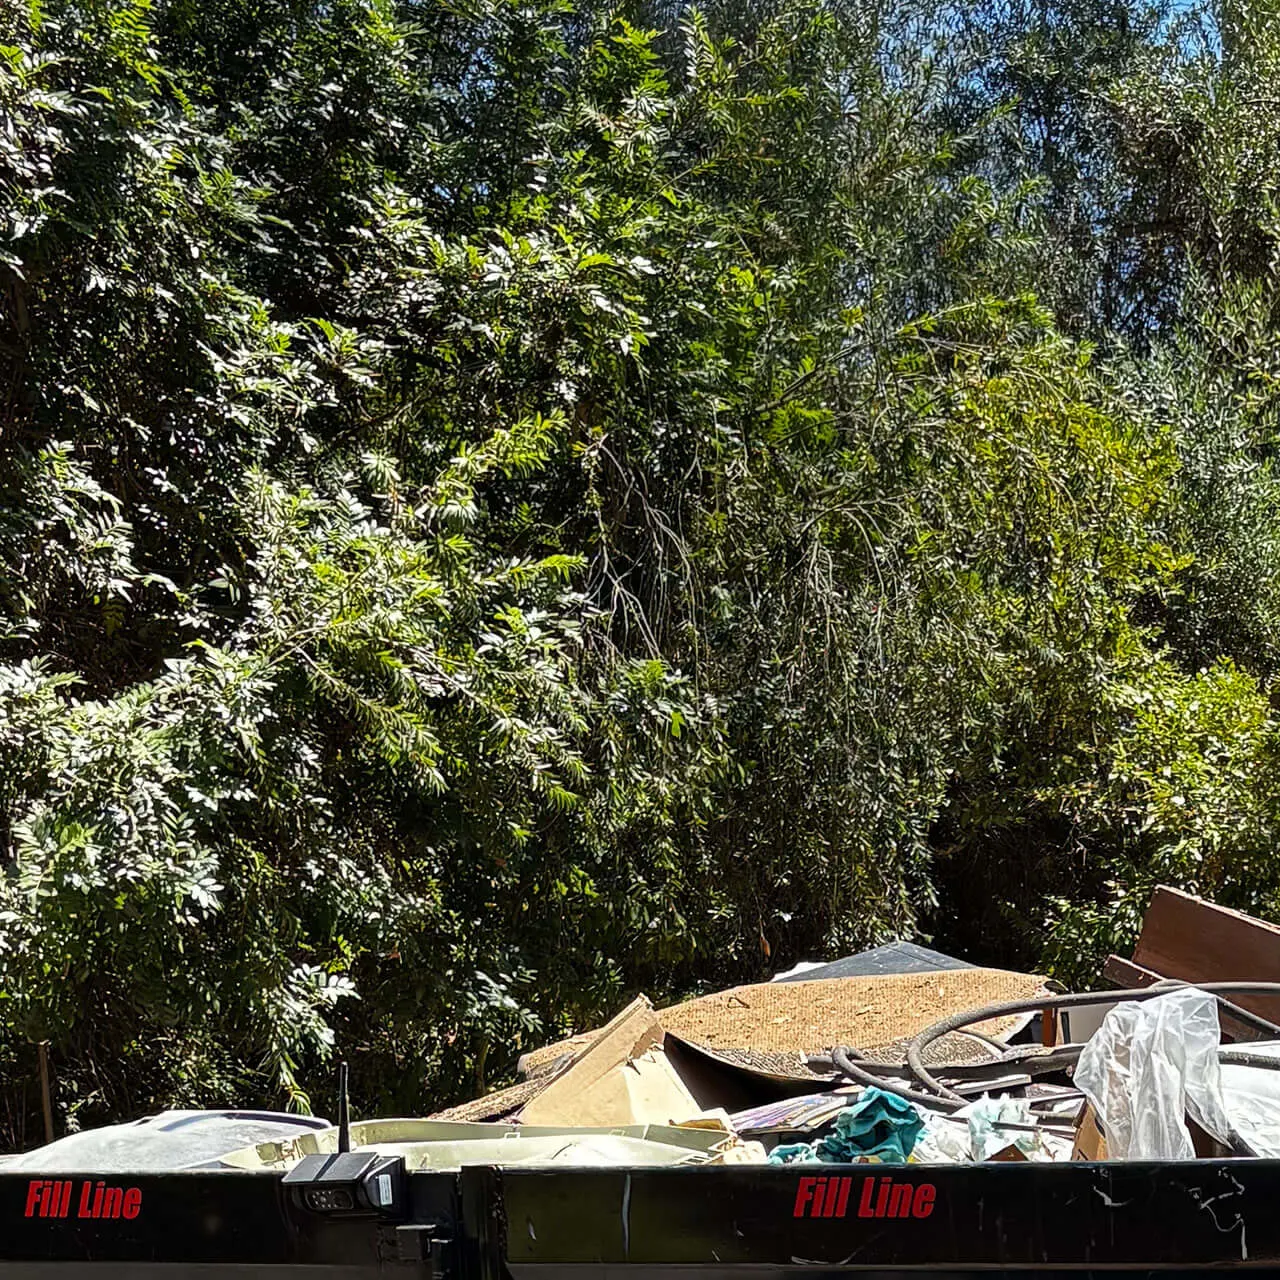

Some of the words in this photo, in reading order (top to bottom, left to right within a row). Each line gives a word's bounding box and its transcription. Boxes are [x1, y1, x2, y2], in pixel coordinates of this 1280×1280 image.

[24, 1180, 73, 1218] Fill
[77, 1180, 143, 1220] Line
[793, 1176, 852, 1218] Fill
[857, 1176, 937, 1219] Line
